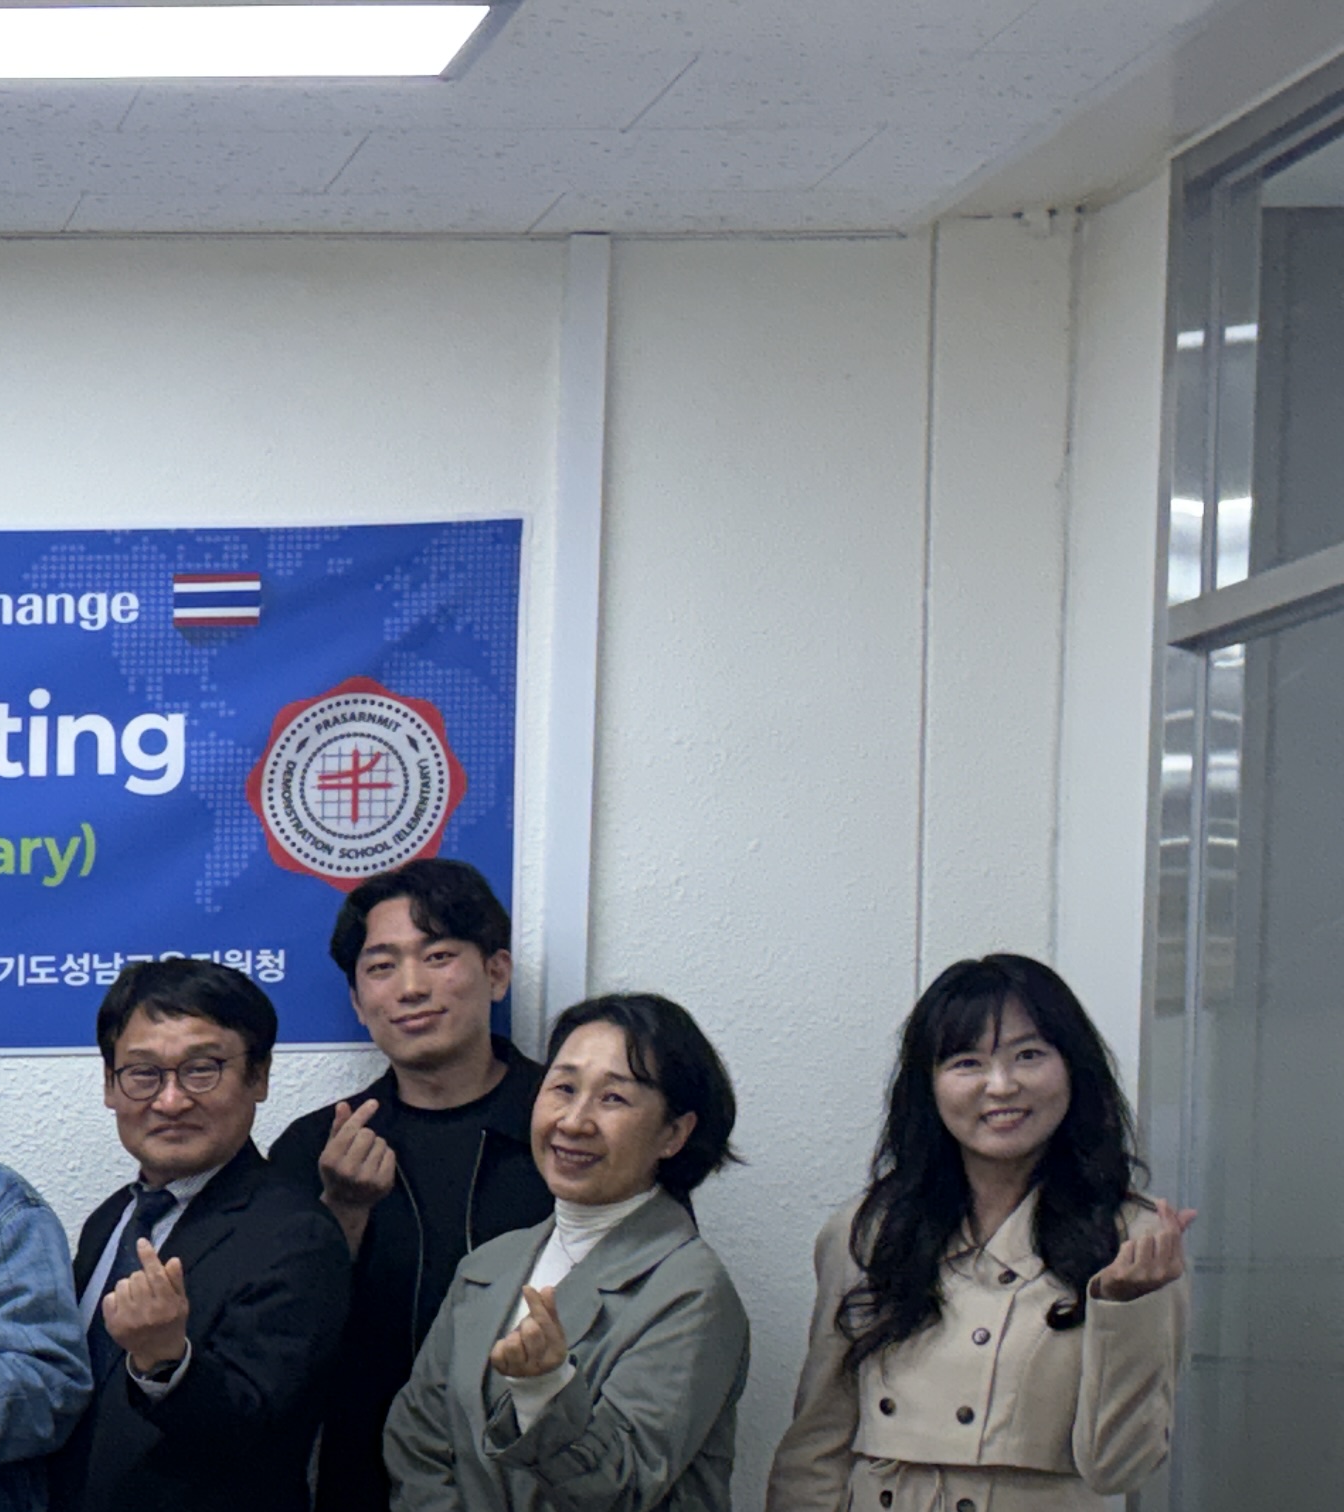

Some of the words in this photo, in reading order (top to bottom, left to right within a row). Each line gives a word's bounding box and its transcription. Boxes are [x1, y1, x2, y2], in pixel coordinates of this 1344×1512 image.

[314, 711, 402, 735] PRASARNMIT
[281, 760, 335, 856] DEMONSTRATION
[338, 839, 393, 860] SCHOOL
